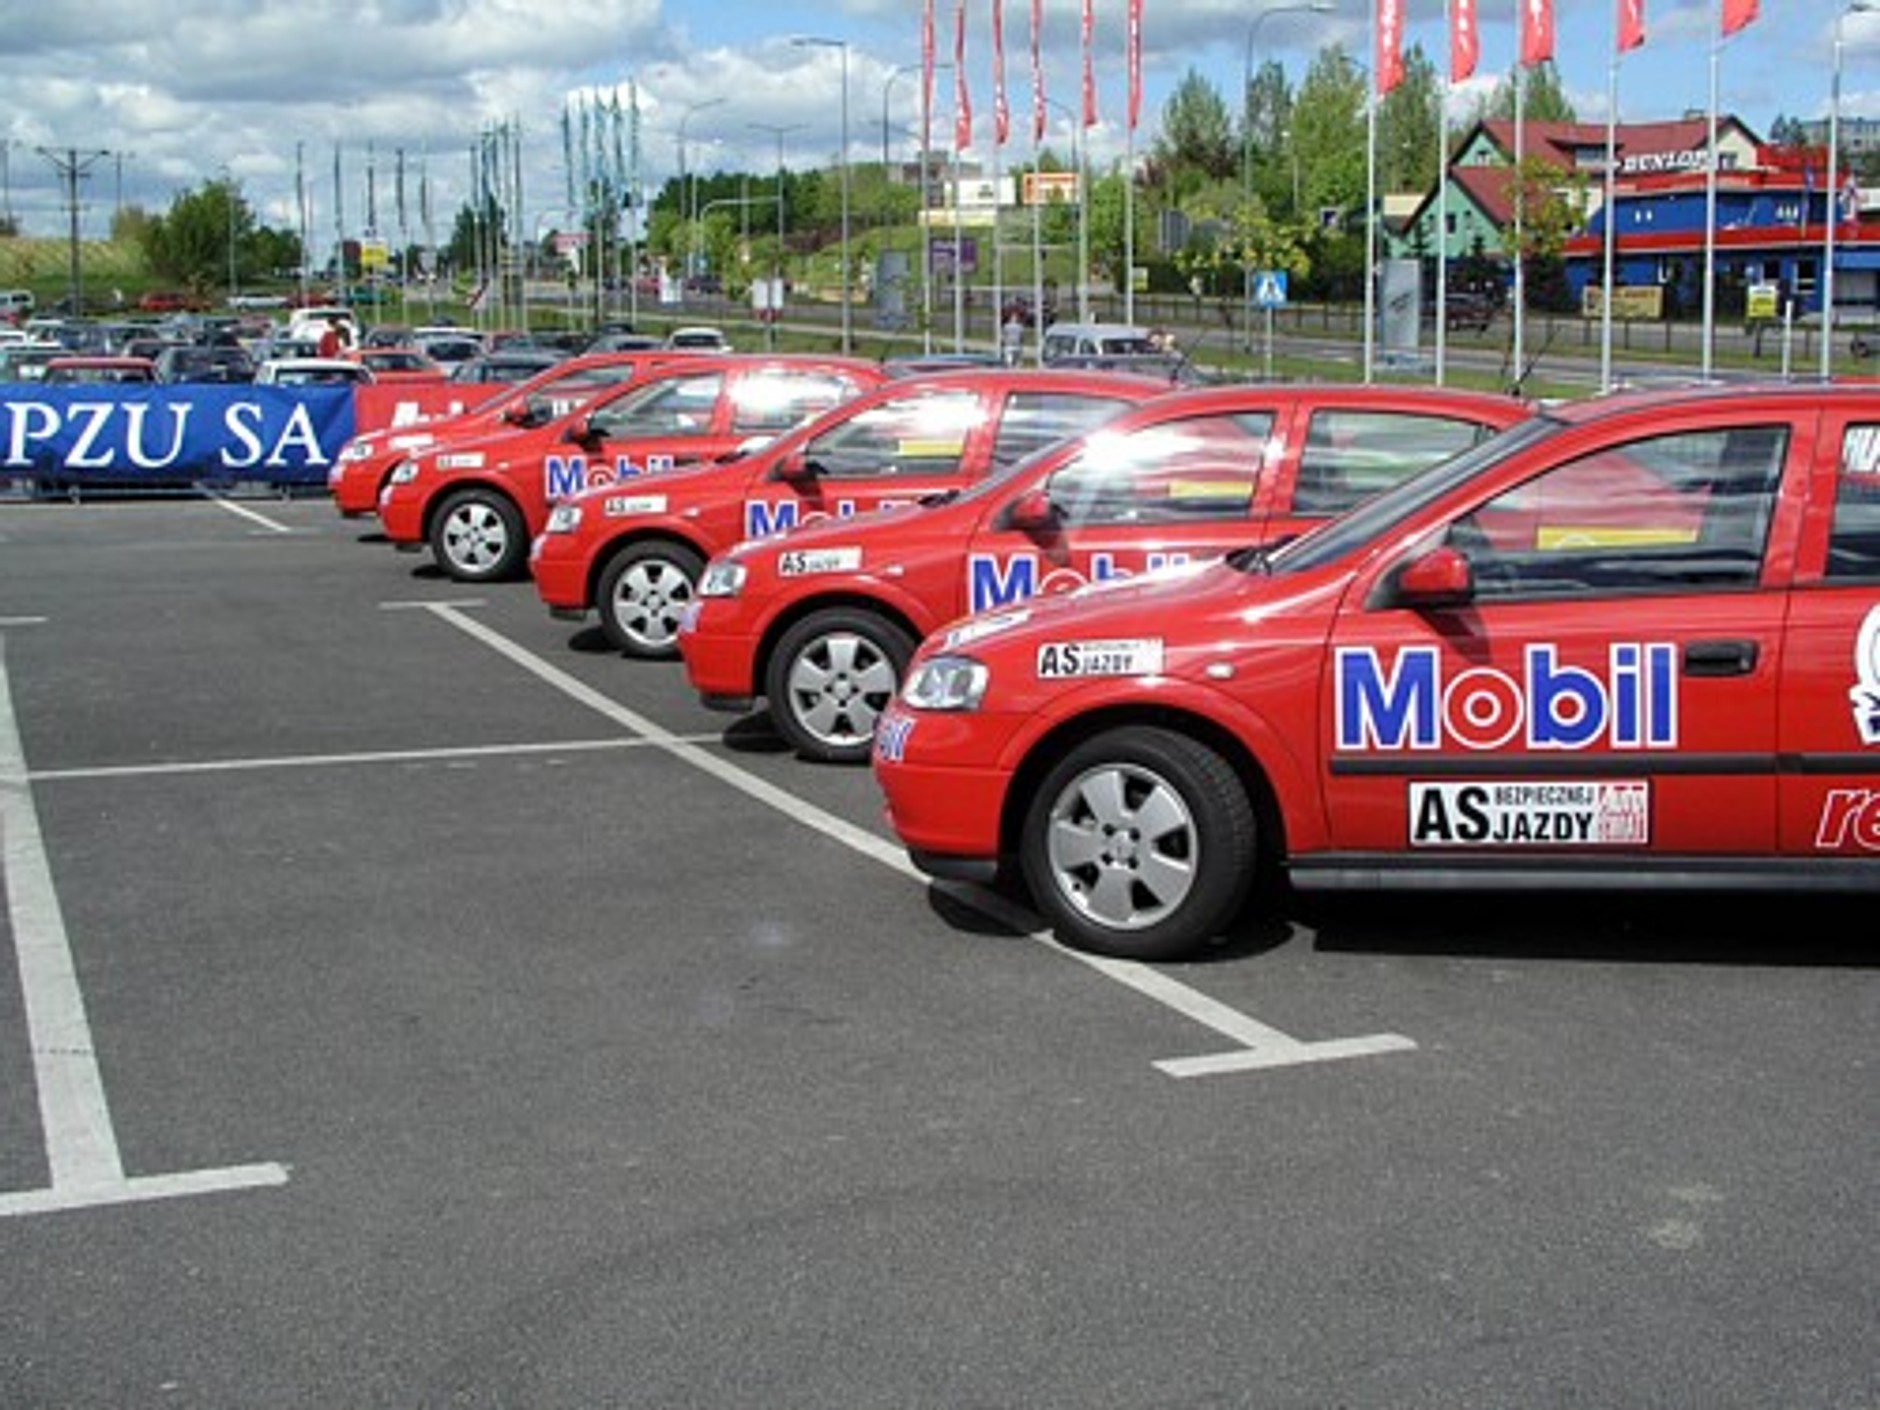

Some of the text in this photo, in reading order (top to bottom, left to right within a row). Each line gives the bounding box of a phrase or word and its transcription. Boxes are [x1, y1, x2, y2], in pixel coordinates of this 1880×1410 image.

[5, 402, 329, 467] PZU SA
[782, 553, 806, 573] AS
[1041, 646, 1080, 675] AS
[1335, 643, 1678, 749] Mobil
[1414, 786, 1491, 841] AS
[1493, 812, 1593, 841] JAZDY
